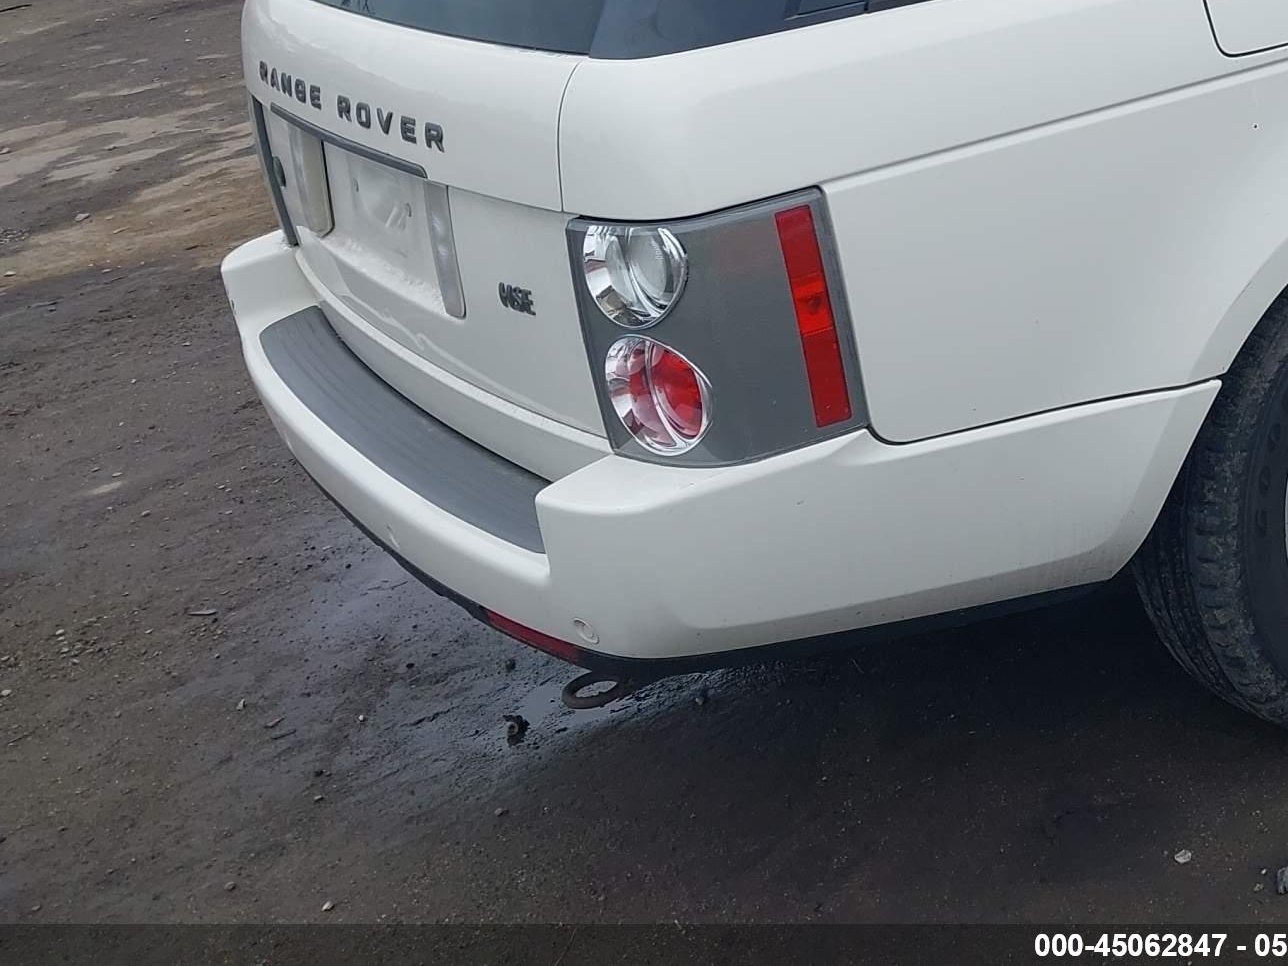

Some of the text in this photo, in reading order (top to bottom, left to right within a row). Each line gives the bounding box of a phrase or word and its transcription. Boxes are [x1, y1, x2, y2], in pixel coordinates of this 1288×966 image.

[259, 60, 445, 153] RANGE ROVER
[498, 281, 537, 316] HSE
